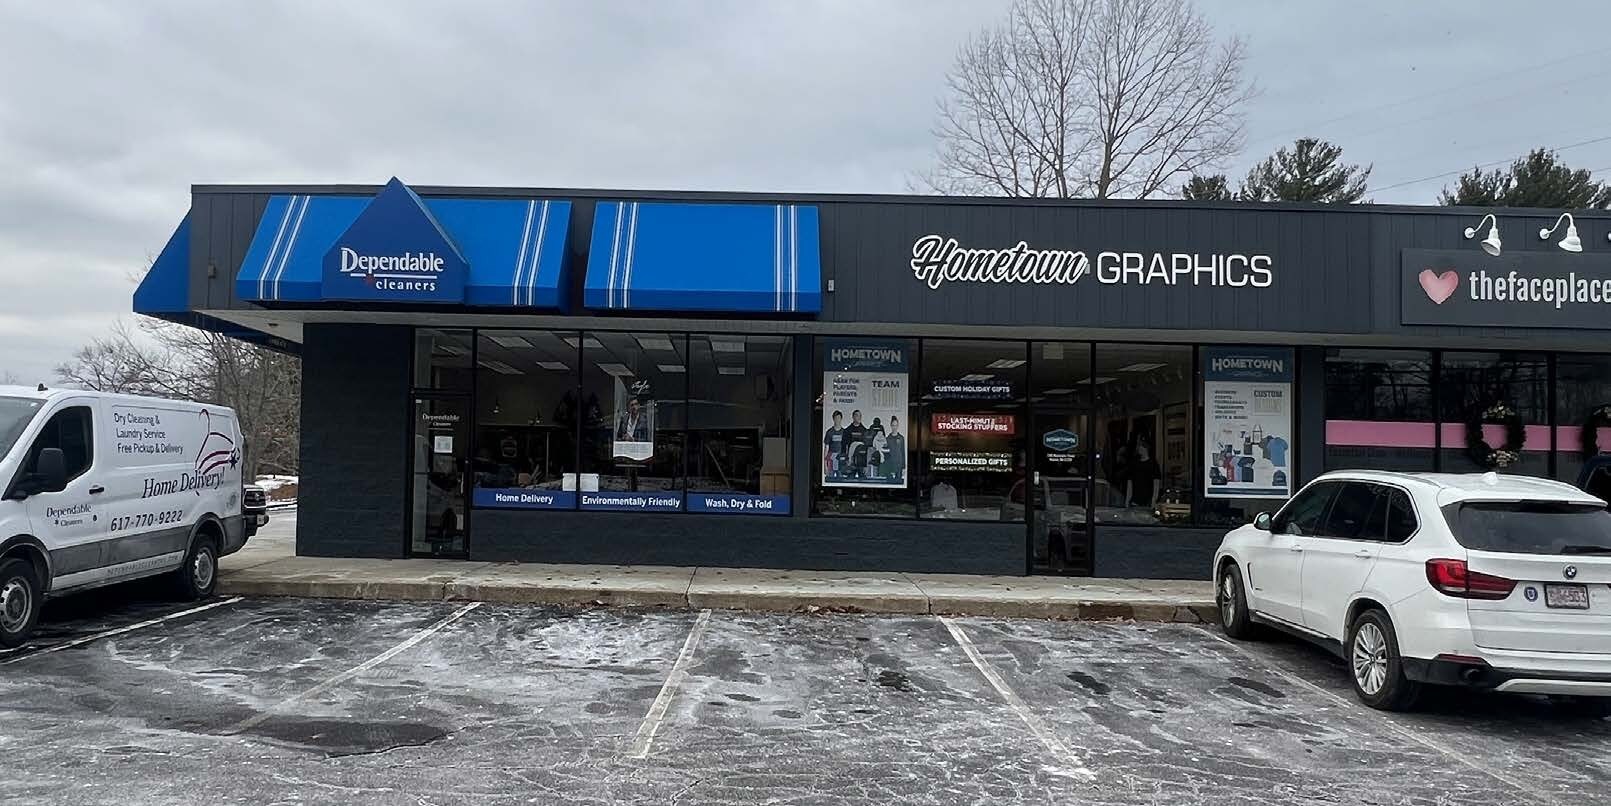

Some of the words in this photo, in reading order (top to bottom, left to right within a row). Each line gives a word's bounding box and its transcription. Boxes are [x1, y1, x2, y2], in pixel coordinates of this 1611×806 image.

[340, 247, 444, 275] Dependable
[910, 234, 1090, 290] Hometown
[1096, 251, 1273, 288] GRAPHICS
[375, 278, 436, 292] cleaners
[1469, 270, 1611, 309] thefaceplace
[831, 348, 902, 363] HOMETOWN
[1211, 358, 1284, 373] HOMETOWN
[871, 380, 900, 388] TEAM
[934, 385, 962, 393] CUSTOM
[962, 385, 991, 393] HOLIDAY
[1254, 390, 1283, 398] CUSTOM
[114, 412, 126, 426] Dry
[127, 412, 155, 427] Cleaning
[973, 423, 1008, 431] STUFFERS
[116, 428, 142, 441] Laundry
[143, 428, 166, 439] Service
[117, 442, 132, 454] Free
[133, 442, 155, 454] Pickup
[155, 443, 160, 453] &
[160, 443, 184, 455] Delivery
[988, 458, 1008, 466] GIFTS
[142, 478, 177, 499] Home
[180, 469, 225, 492] Delivery!
[496, 493, 520, 503] Home
[521, 493, 554, 506] Delivery
[582, 495, 647, 508] Environmentally
[648, 497, 681, 509] Friendly
[705, 498, 729, 509] Wash,
[731, 499, 746, 510] Dry
[746, 500, 754, 509] &
[755, 500, 772, 510] Fold
[46, 503, 92, 519] Dependable
[110, 510, 183, 532] 617-770-9222
